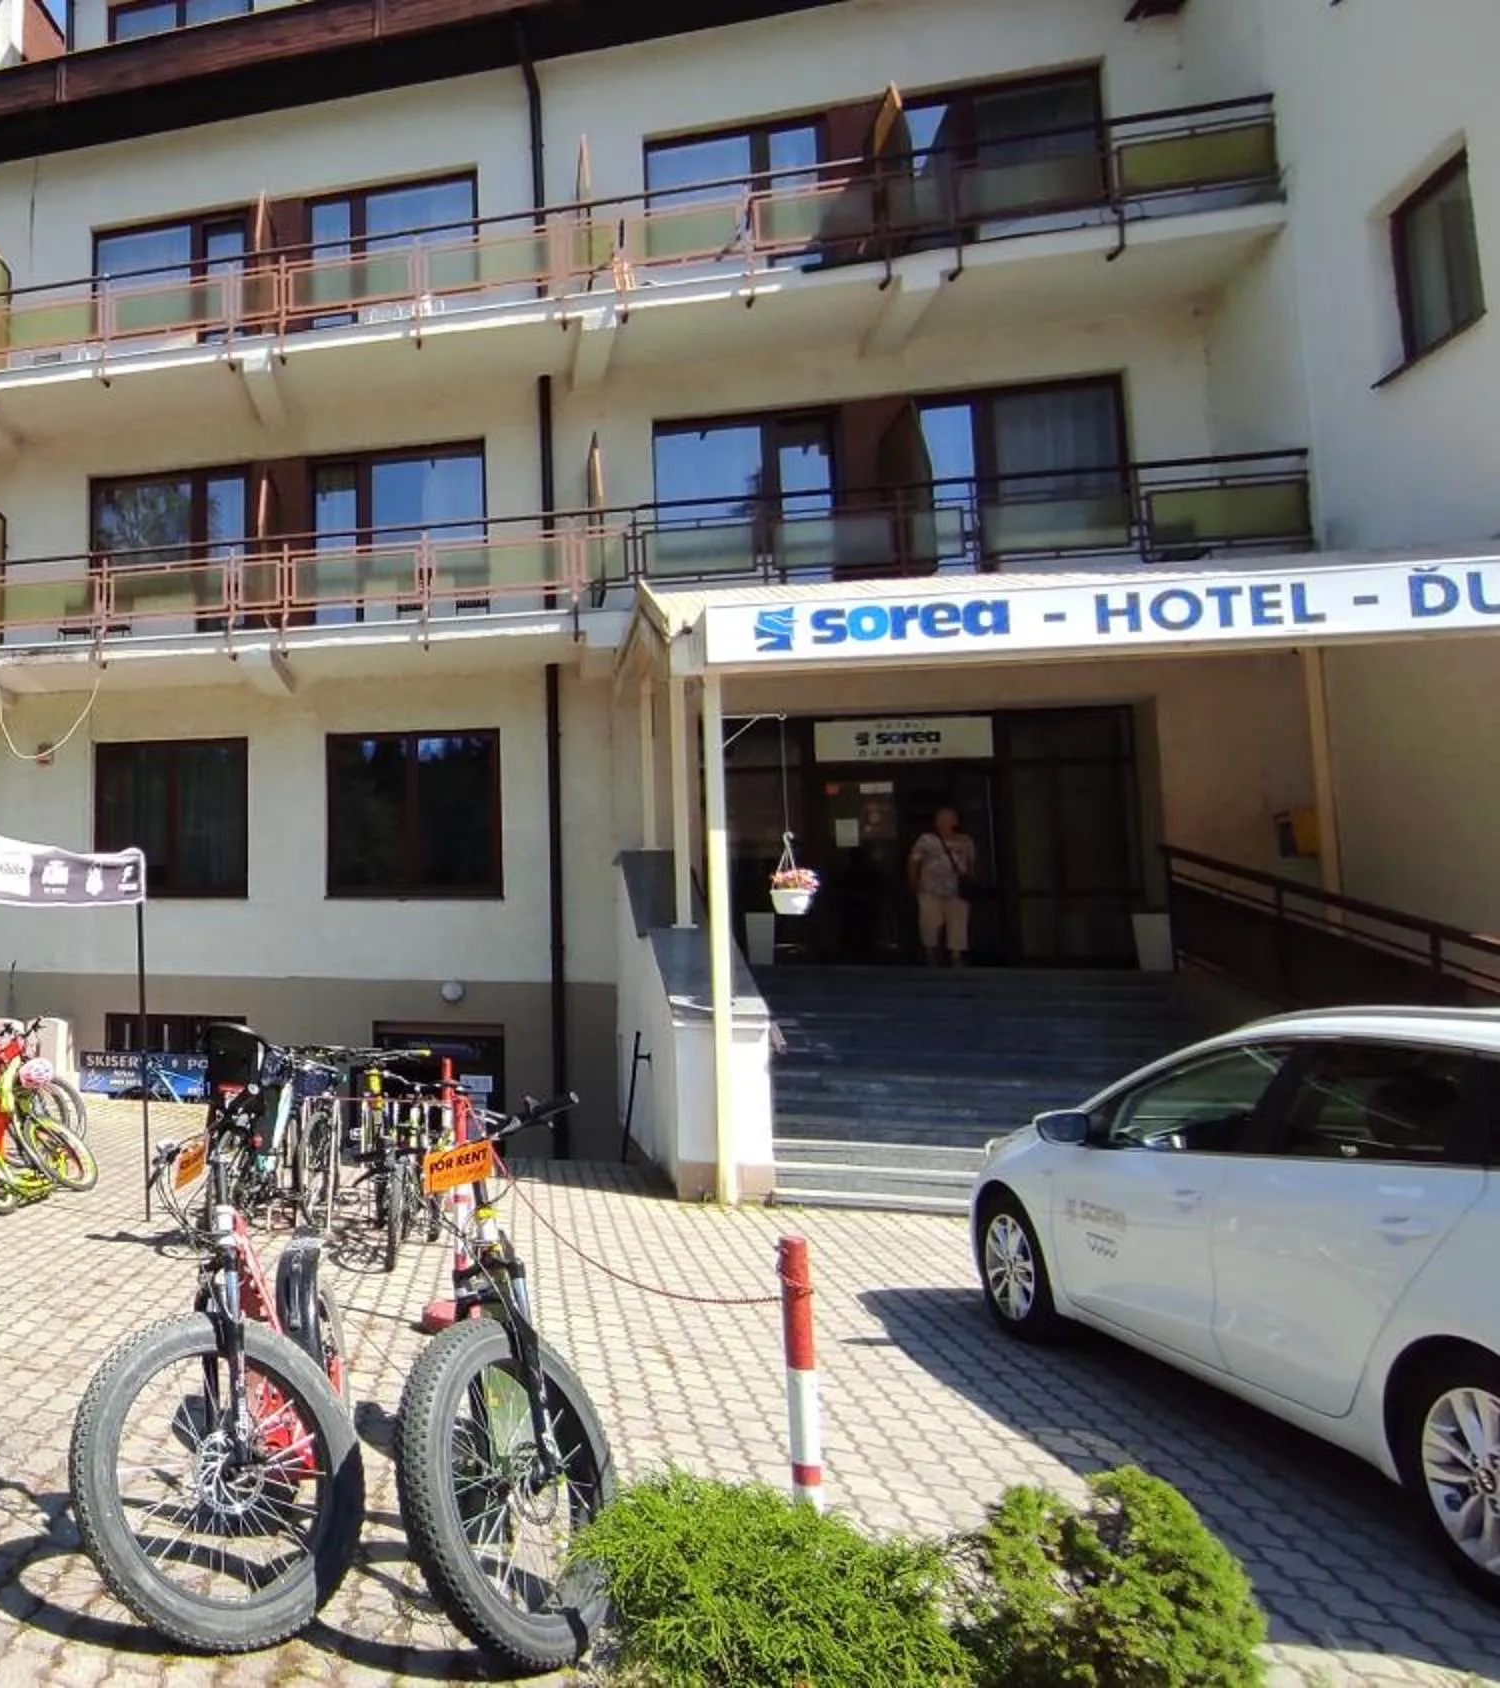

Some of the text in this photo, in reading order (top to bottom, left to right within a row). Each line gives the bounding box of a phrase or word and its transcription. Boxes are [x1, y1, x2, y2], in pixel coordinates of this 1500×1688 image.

[810, 599, 1011, 645] sorea
[1094, 582, 1327, 634] HOTEL
[875, 731, 941, 745] sorea
[455, 1147, 489, 1167] RENT
